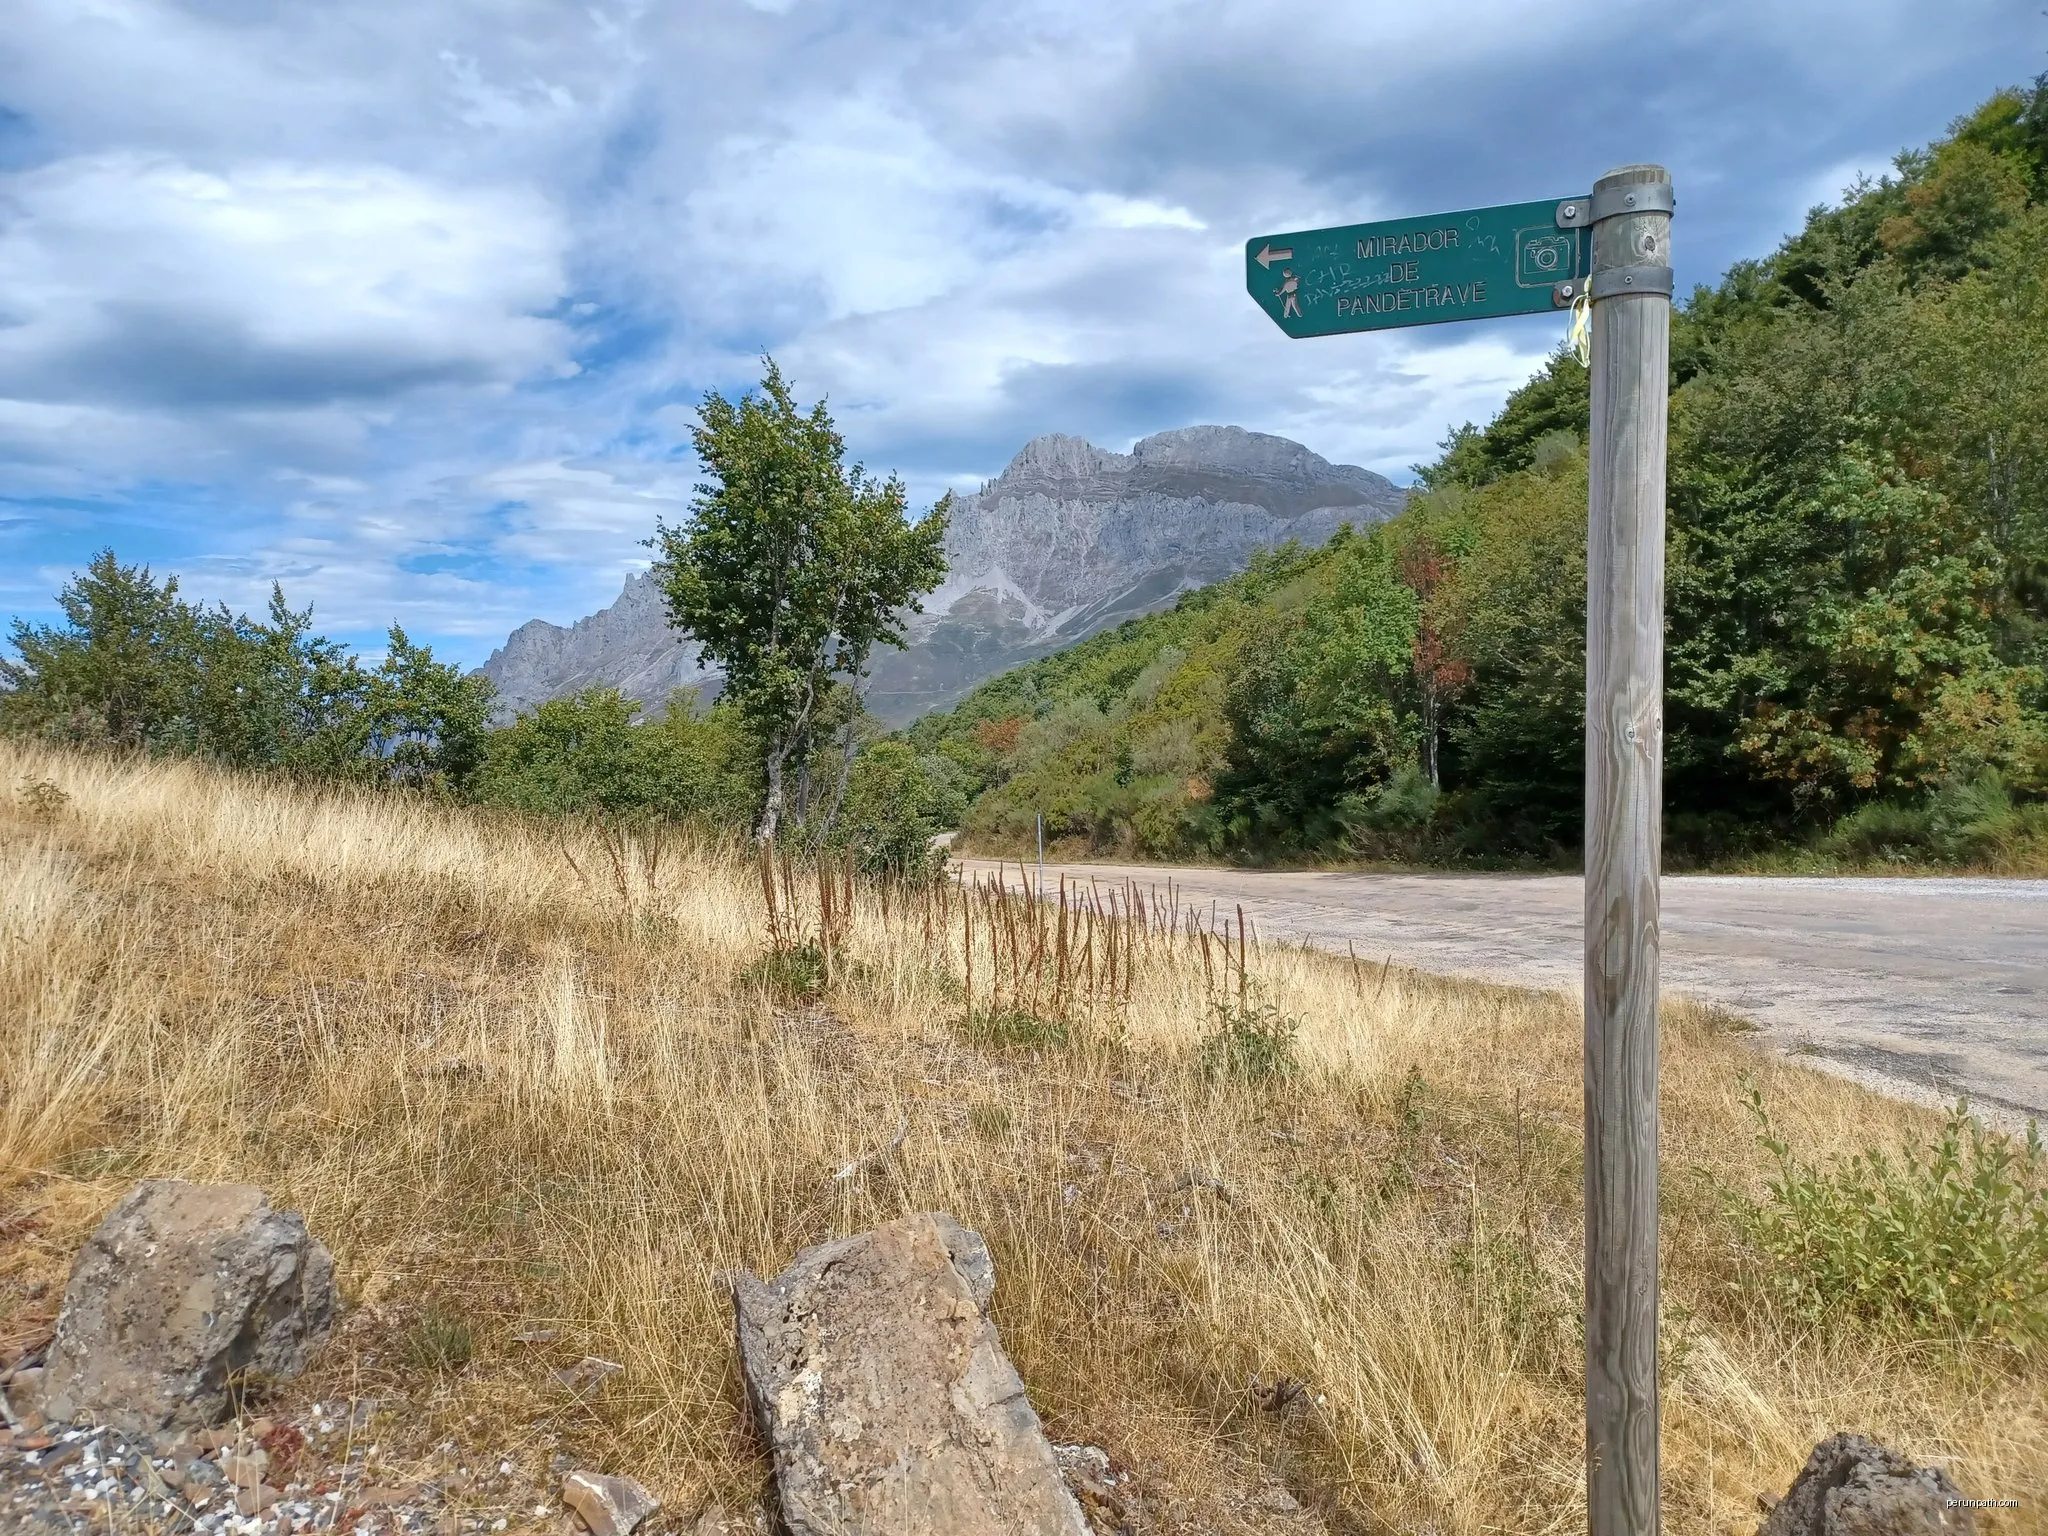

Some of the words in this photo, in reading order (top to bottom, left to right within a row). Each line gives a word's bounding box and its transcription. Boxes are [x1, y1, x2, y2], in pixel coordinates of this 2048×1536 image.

[1356, 228, 1459, 259] MIRADOR
[1389, 260, 1419, 284] DE
[1337, 282, 1487, 317] PANDETRAVE
